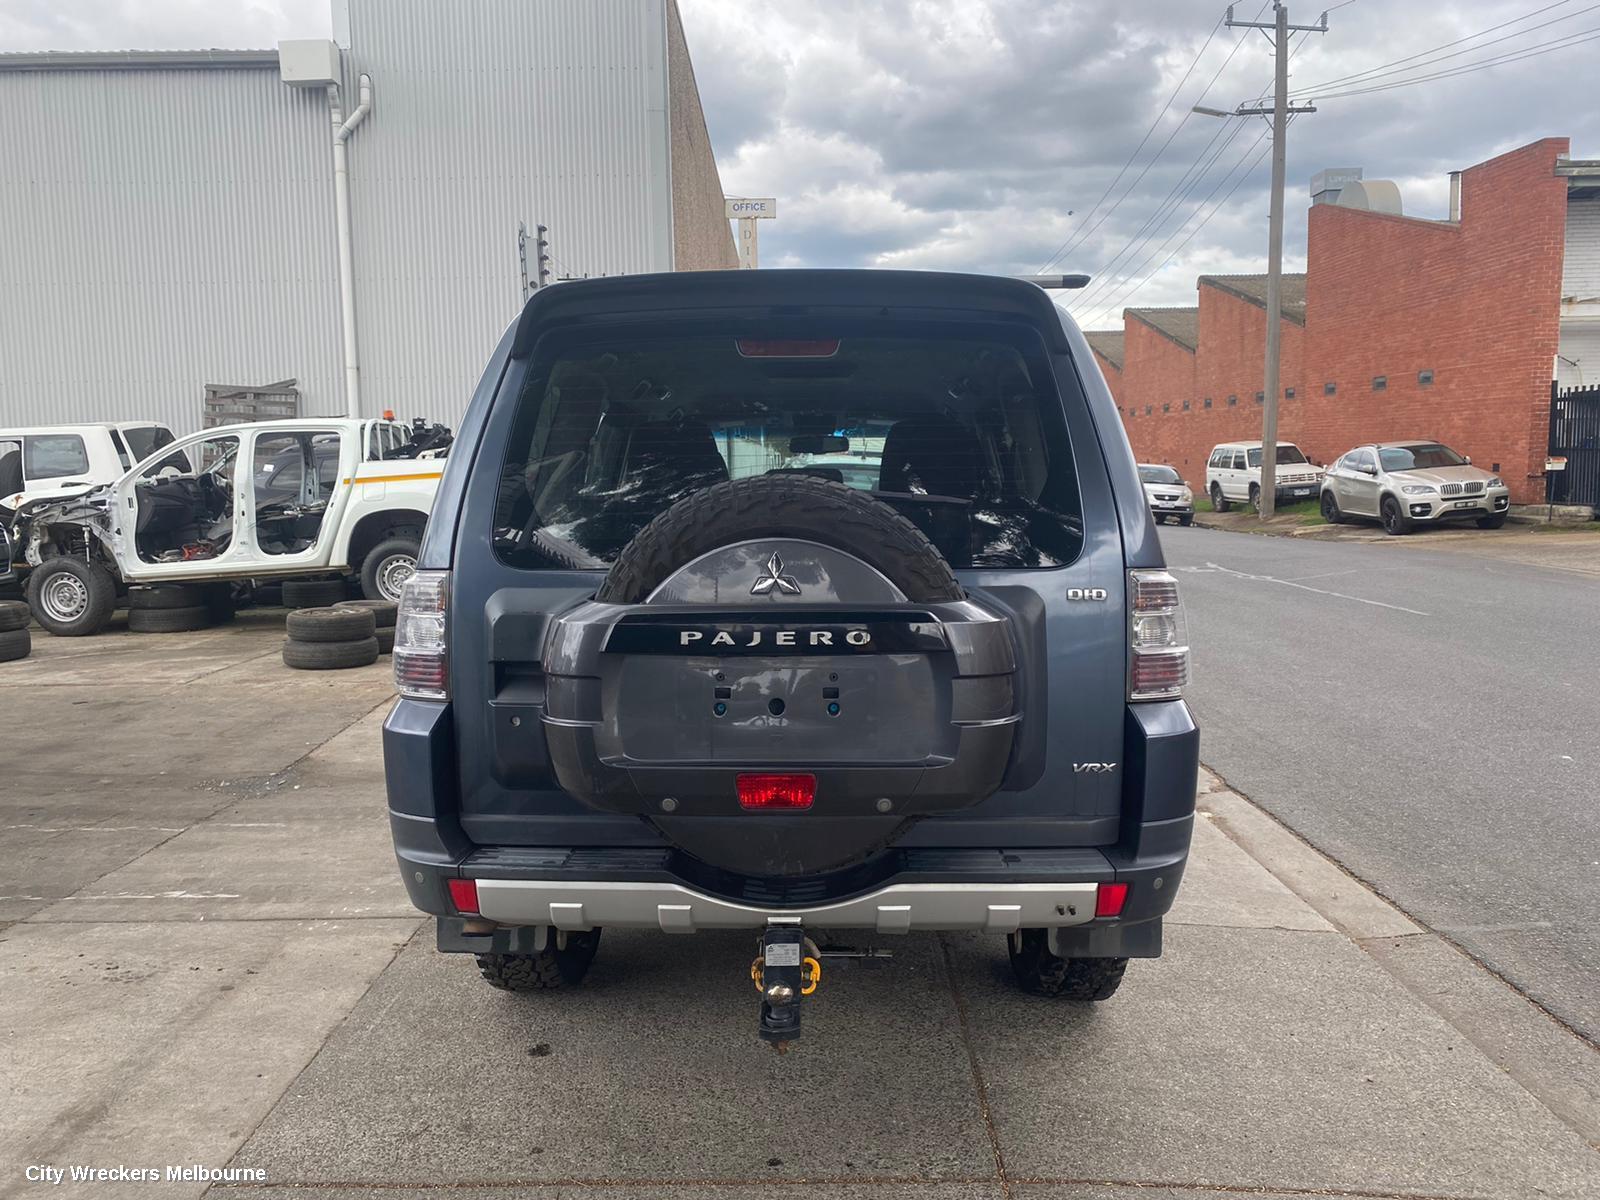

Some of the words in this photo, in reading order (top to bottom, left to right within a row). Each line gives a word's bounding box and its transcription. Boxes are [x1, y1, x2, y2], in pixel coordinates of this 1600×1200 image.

[732, 203, 767, 212] OFFICE
[680, 631, 871, 646] PAJERO
[1072, 762, 1117, 774] VRX
